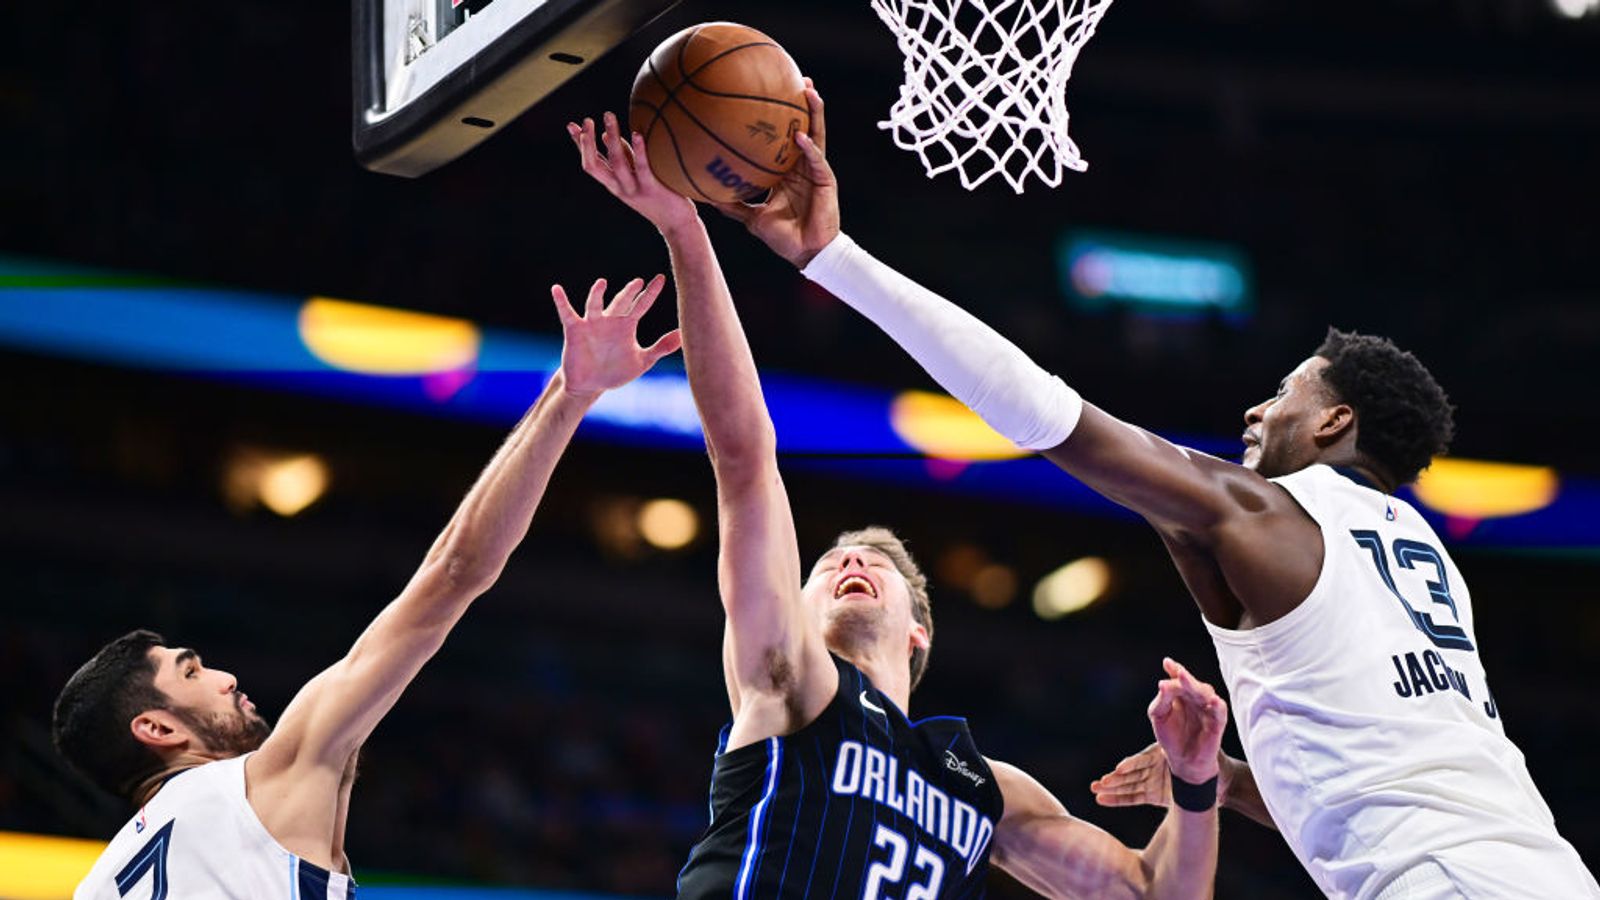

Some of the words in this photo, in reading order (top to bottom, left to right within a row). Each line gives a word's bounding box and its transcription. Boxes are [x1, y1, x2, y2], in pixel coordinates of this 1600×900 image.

[1350, 529, 1475, 652] 13
[832, 741, 994, 876] ORLANDO
[862, 823, 947, 900] 22
